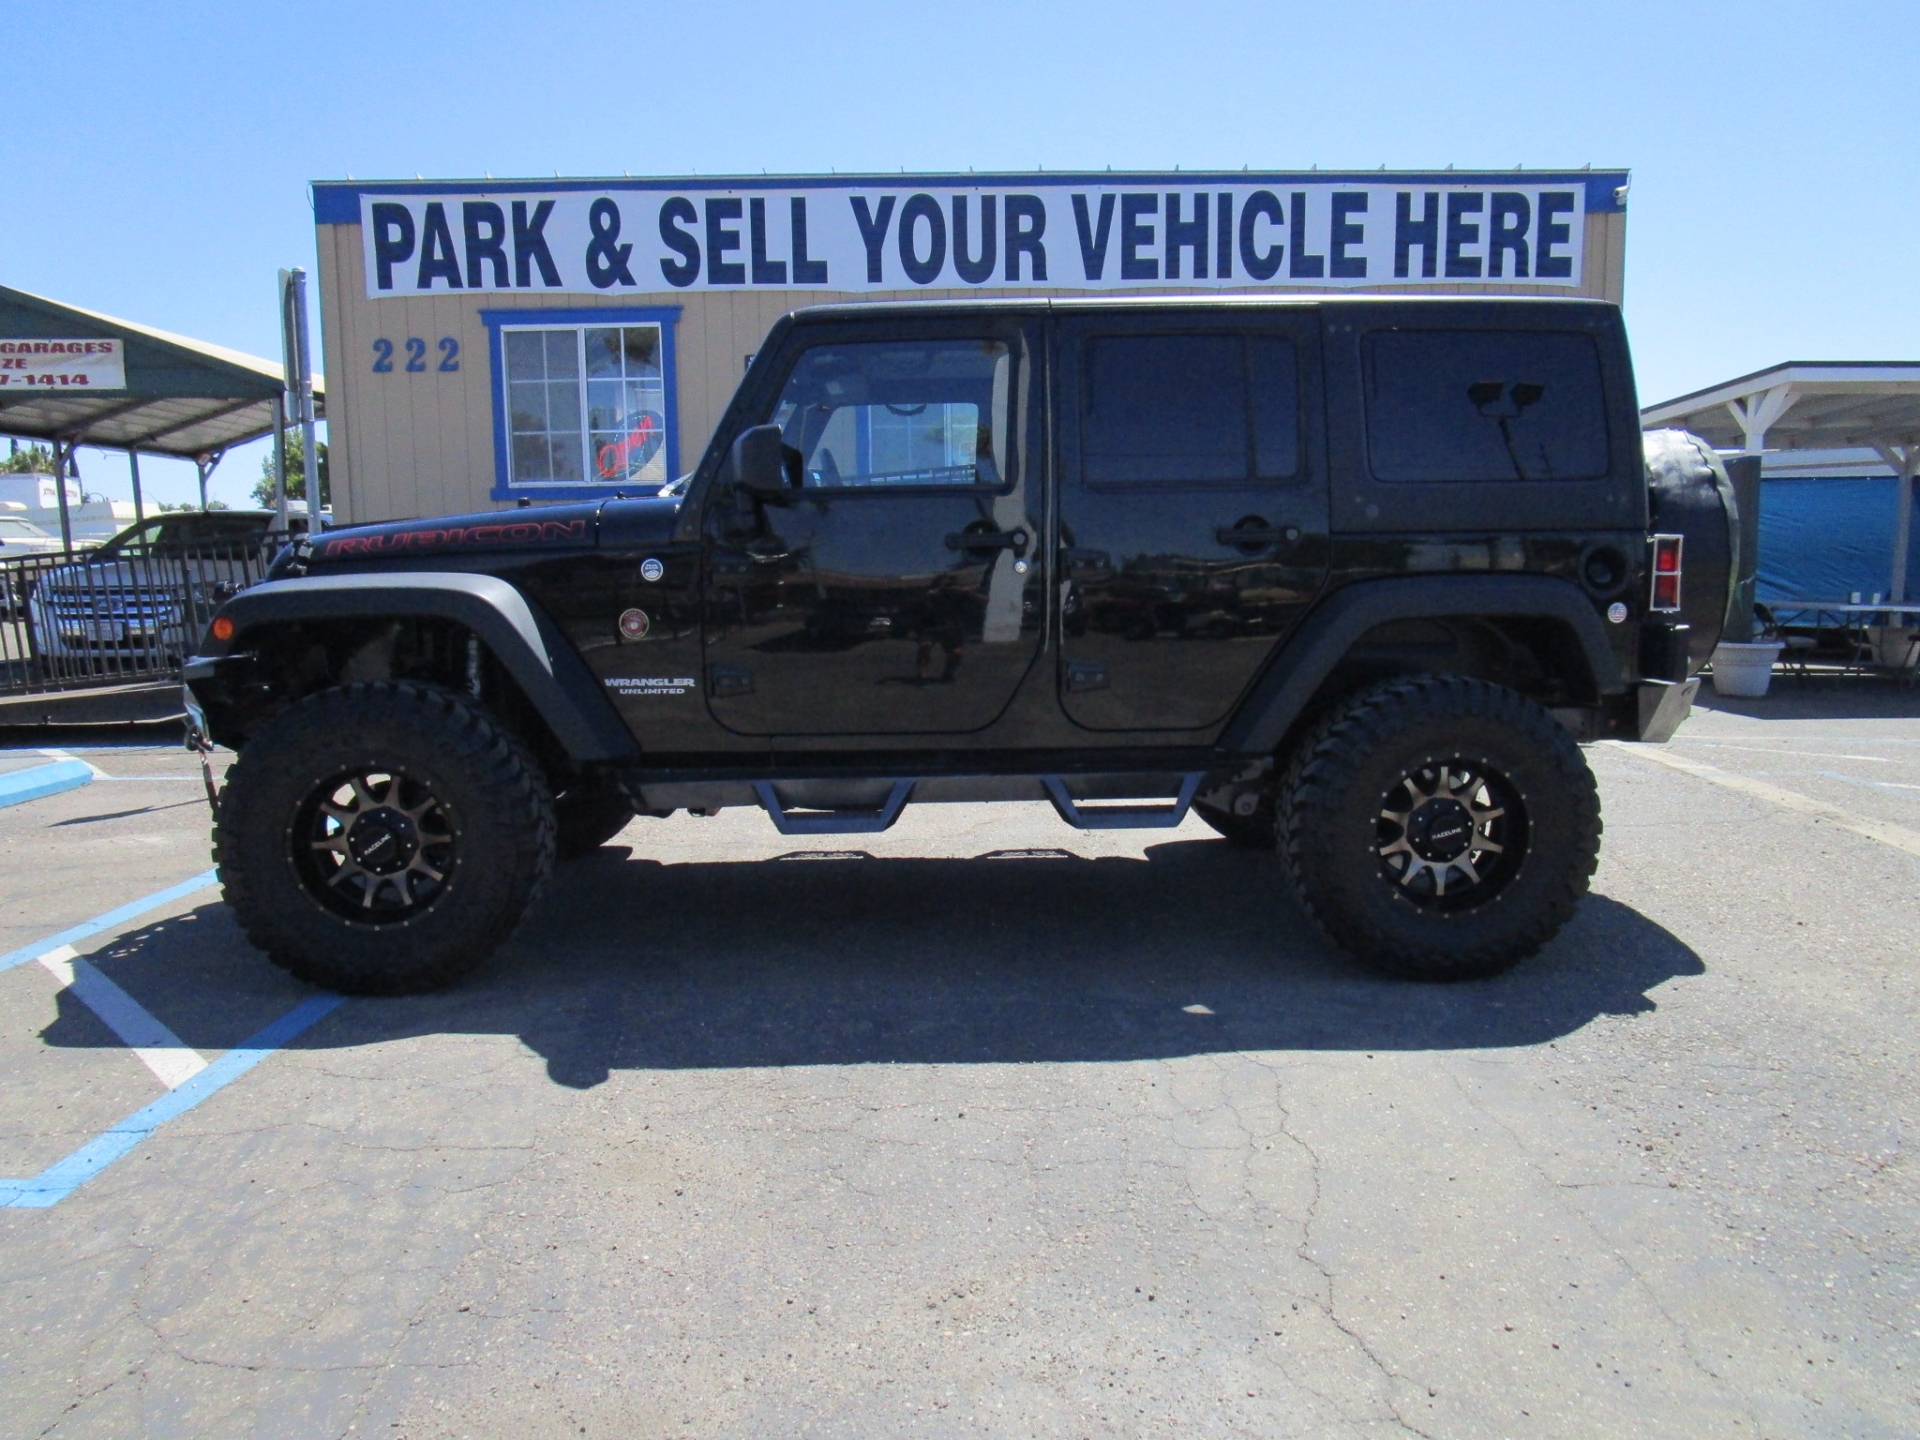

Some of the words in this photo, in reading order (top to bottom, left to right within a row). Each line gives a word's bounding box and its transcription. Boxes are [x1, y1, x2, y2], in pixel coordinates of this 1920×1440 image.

[372, 200, 562, 289] PARK
[585, 197, 637, 288] &
[659, 196, 828, 287] SELL
[849, 193, 1047, 285] YOUR
[1071, 190, 1368, 280] VEHICLE
[1394, 192, 1574, 277] HERE
[0, 342, 113, 354] GARAGES
[372, 337, 460, 373] 222
[597, 416, 653, 477] Open
[325, 520, 585, 555] RUBICON
[603, 678, 695, 687] WRANGLER
